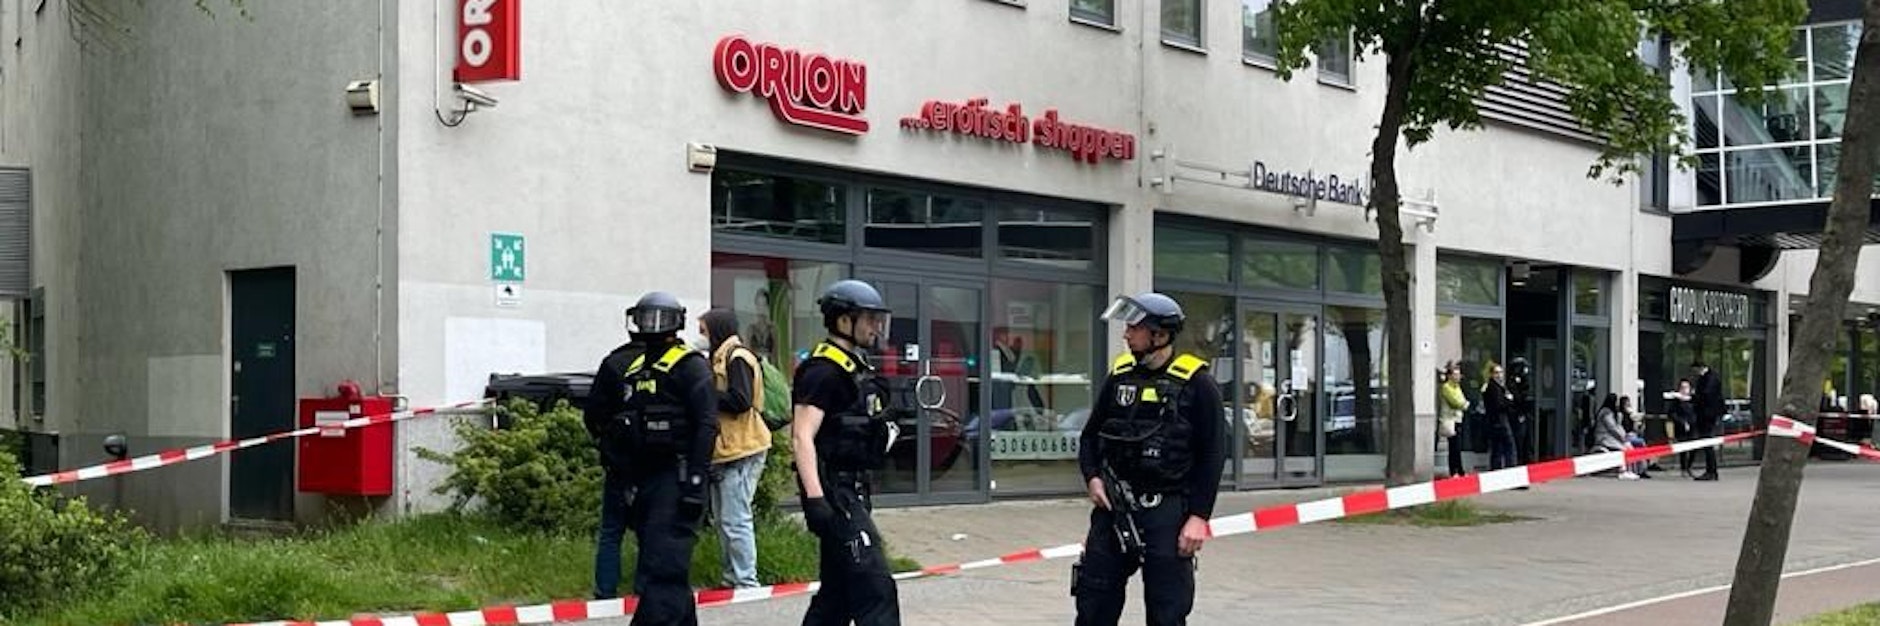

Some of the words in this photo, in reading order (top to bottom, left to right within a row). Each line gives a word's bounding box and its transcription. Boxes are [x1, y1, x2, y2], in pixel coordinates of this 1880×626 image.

[714, 36, 869, 134] ORION
[1032, 110, 1135, 164] shoppen
[1254, 161, 1325, 200] Deutsche
[1329, 174, 1365, 206] Bank
